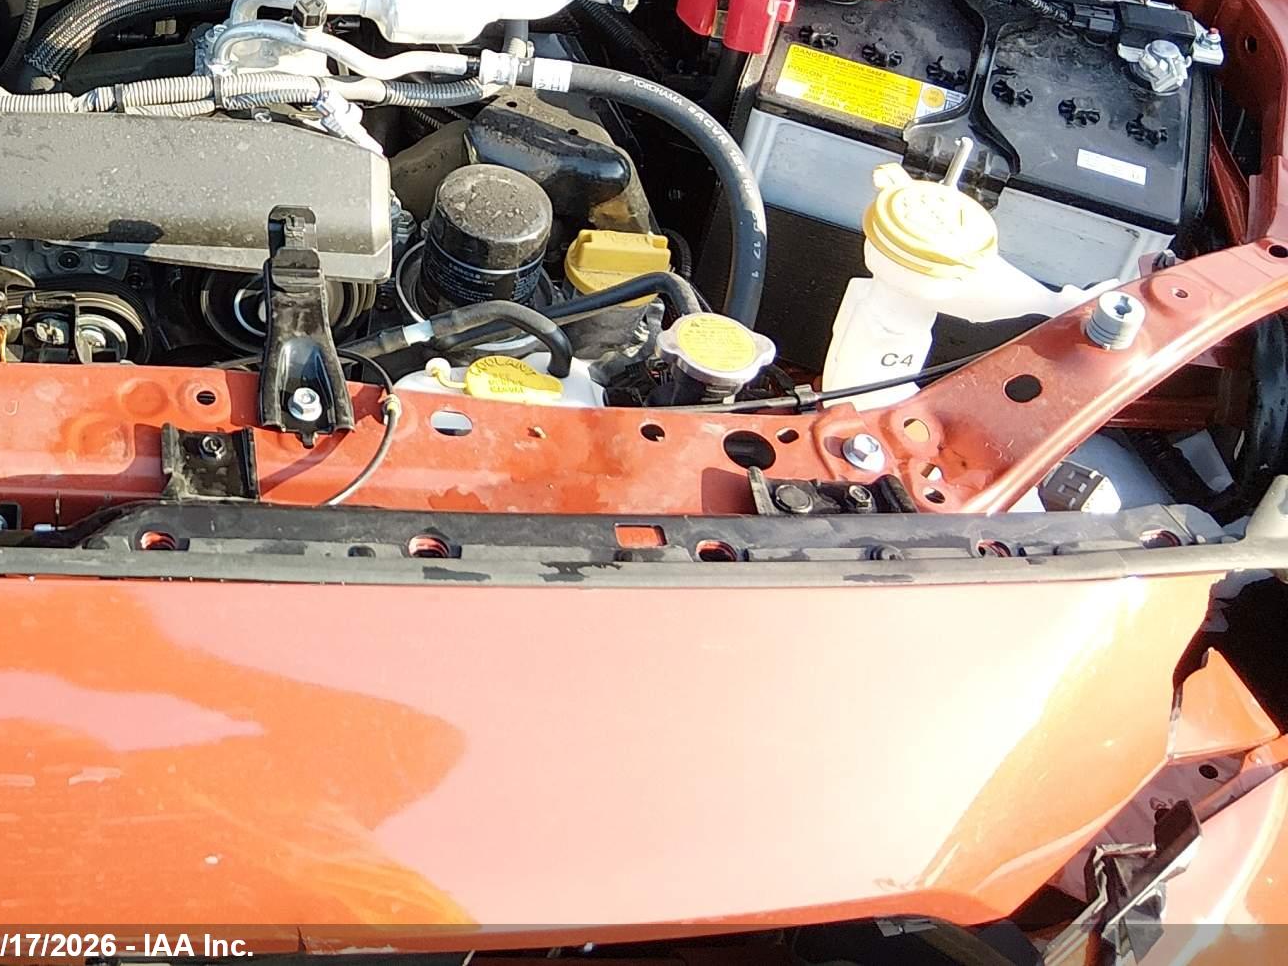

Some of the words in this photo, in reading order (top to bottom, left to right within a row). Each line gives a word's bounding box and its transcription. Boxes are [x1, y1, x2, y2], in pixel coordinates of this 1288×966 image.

[793, 46, 830, 62] DANGER
[633, 79, 683, 107] YOKOHAMA
[881, 353, 914, 367] C4
